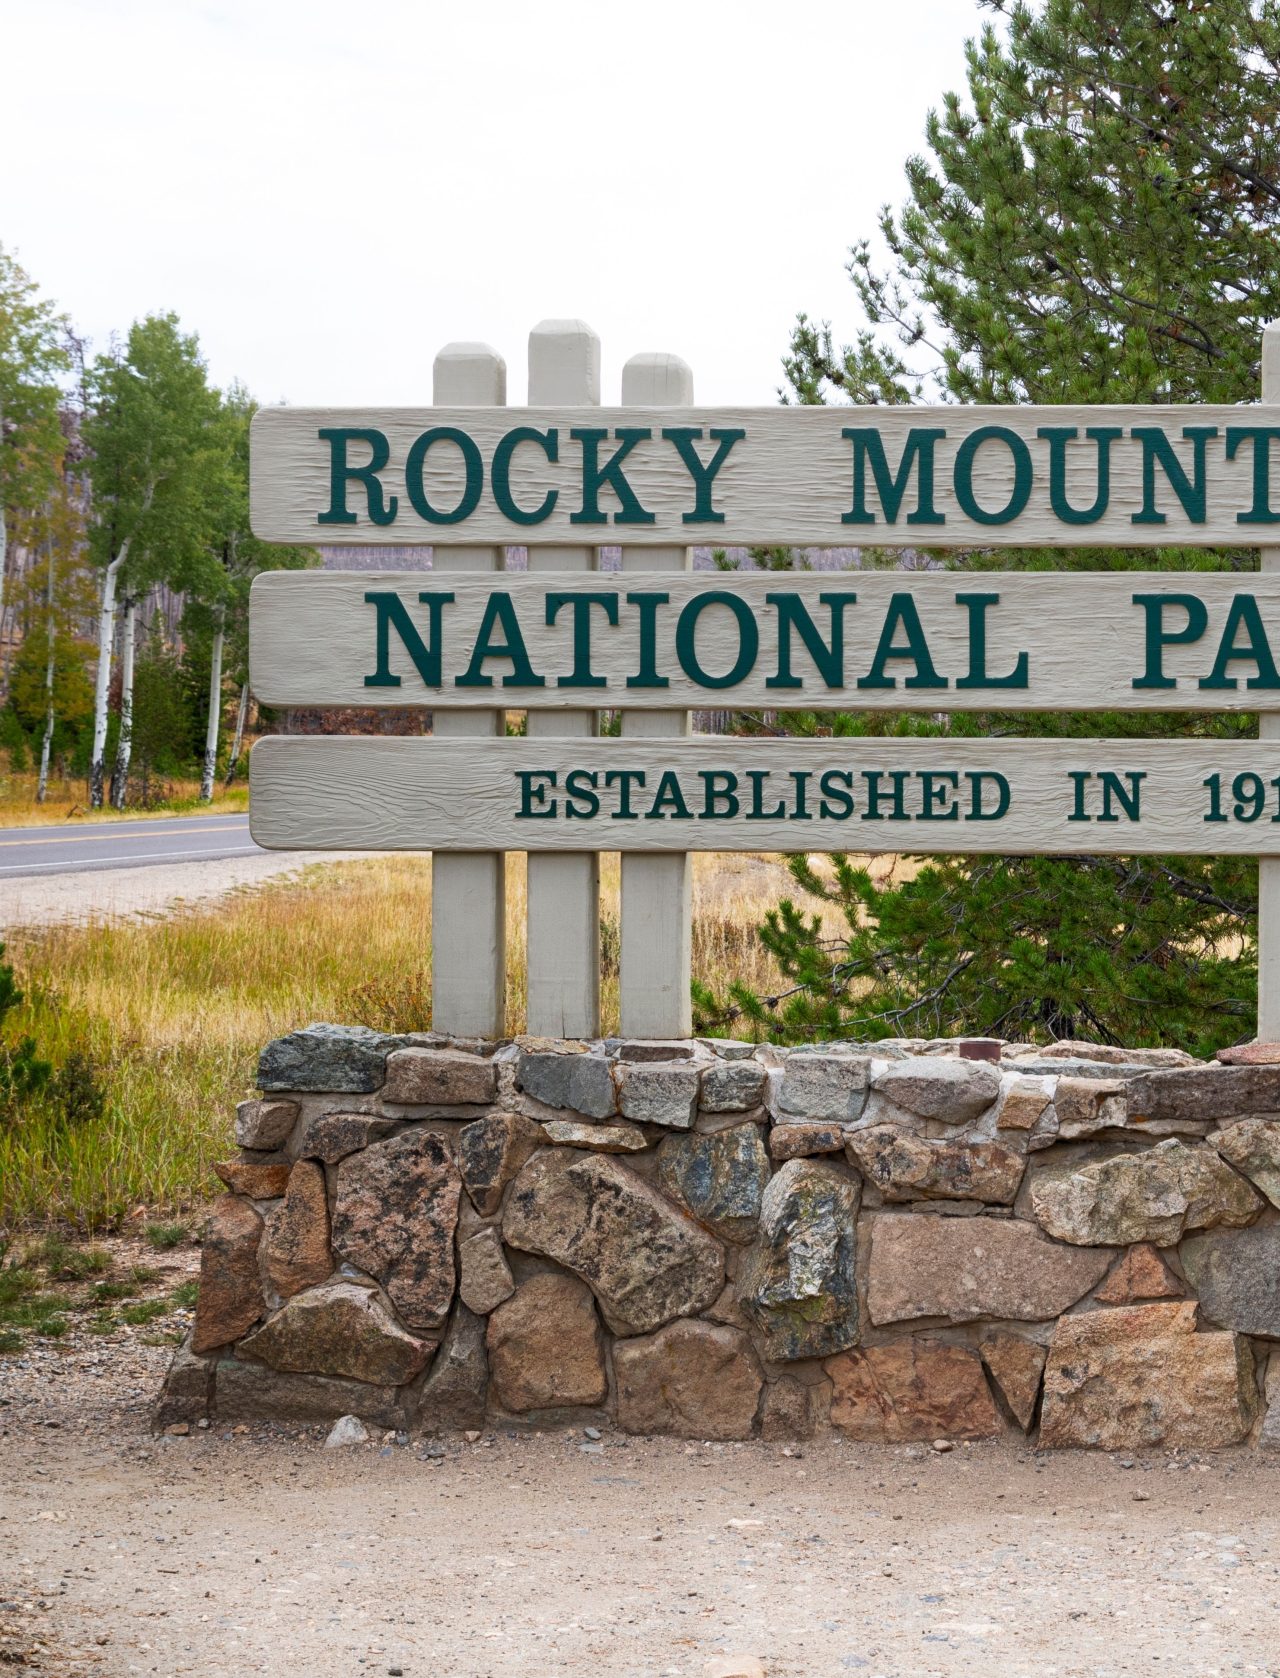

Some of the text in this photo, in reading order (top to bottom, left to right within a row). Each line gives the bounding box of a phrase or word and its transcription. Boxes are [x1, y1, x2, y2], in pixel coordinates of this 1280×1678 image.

[317, 426, 746, 526] ROCKY
[364, 590, 1029, 690] NATIONAL
[514, 769, 1011, 822] ESTABLISHED
[1067, 771, 1147, 822] IN
